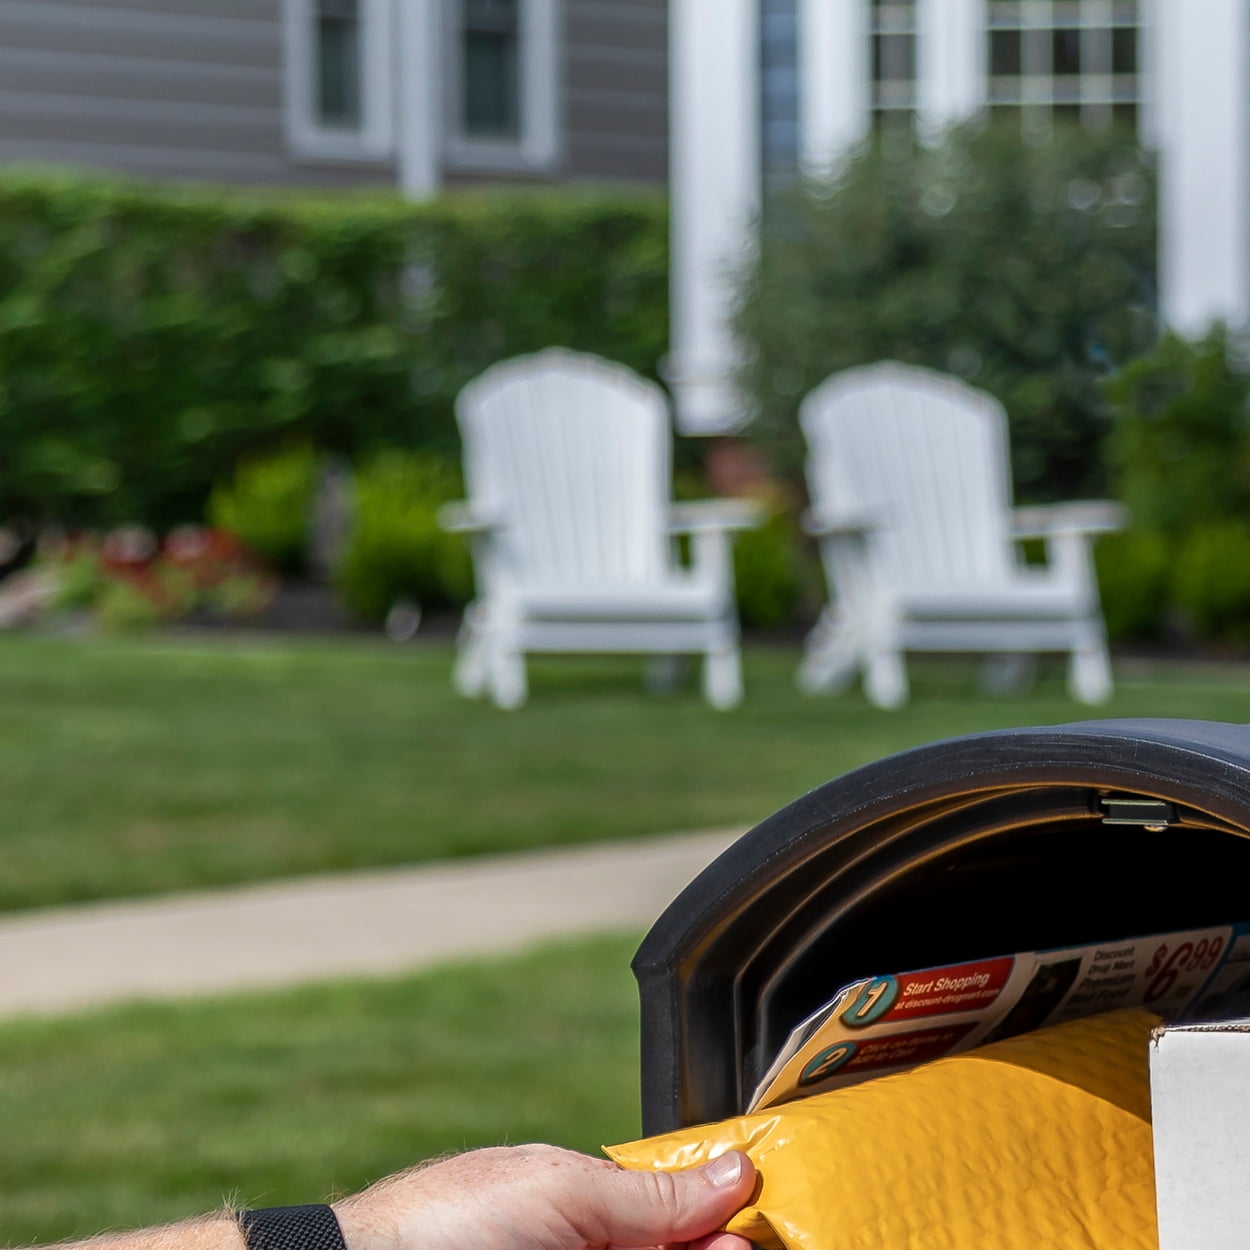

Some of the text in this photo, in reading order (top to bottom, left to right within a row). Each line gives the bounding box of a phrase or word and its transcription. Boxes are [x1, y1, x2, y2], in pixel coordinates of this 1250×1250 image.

[903, 972, 991, 996] Start Shopping
[894, 1001, 904, 1010] at
